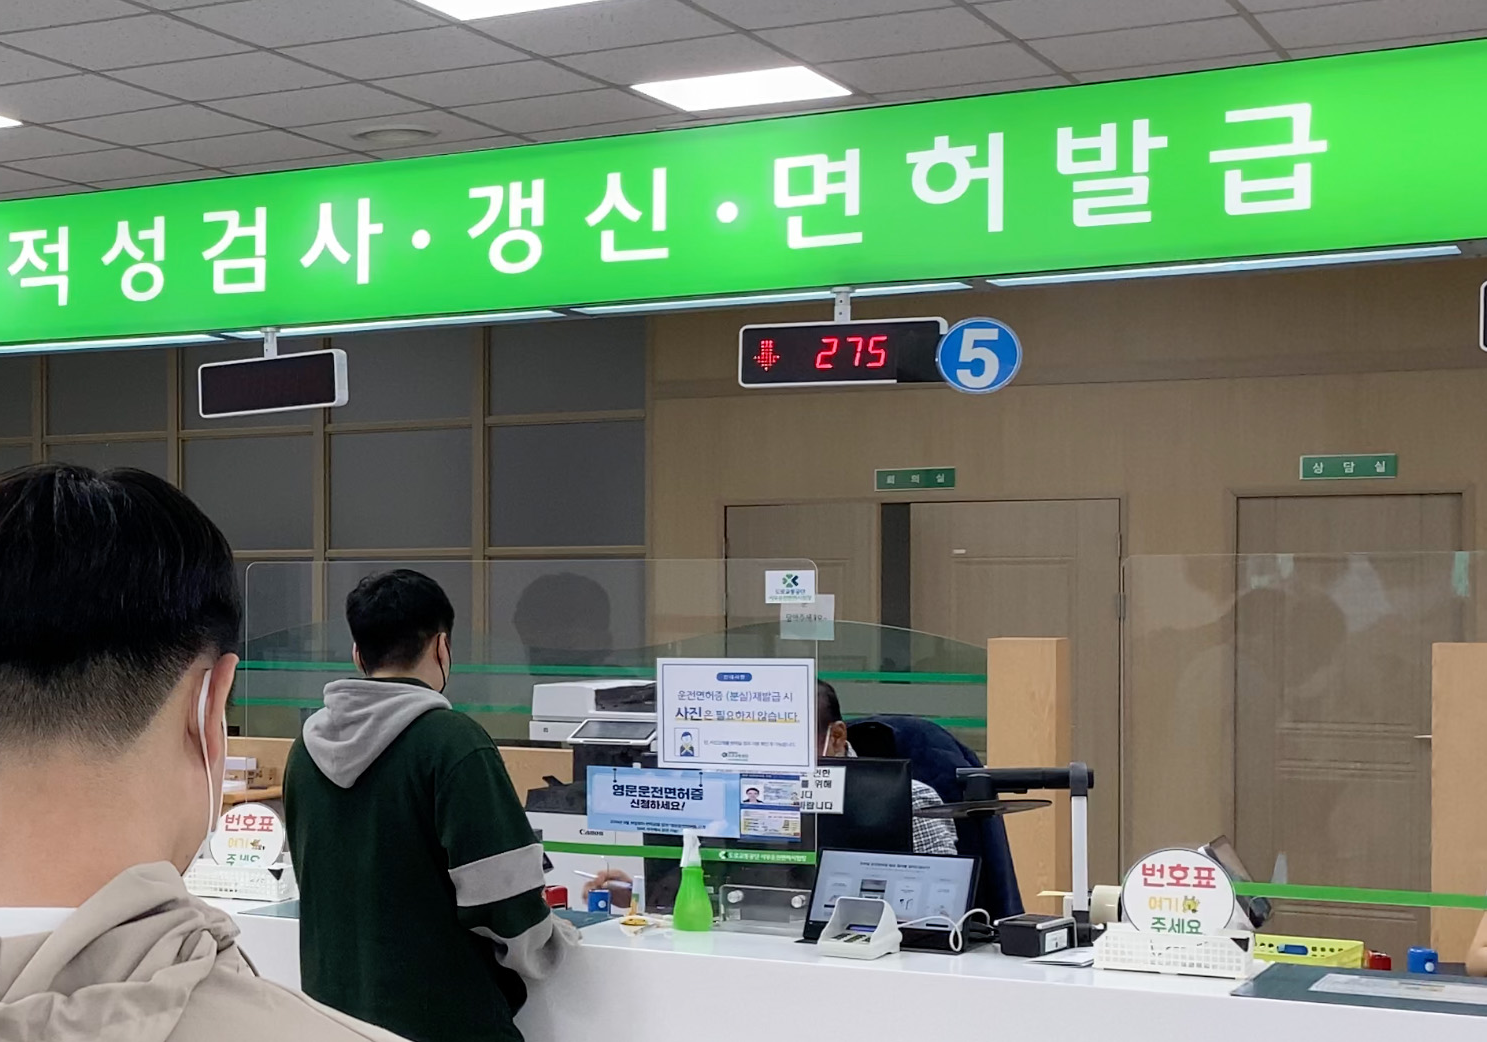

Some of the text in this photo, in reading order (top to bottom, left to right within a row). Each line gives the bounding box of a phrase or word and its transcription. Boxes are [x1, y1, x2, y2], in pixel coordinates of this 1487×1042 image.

[814, 328, 1000, 389] 275 5
[1312, 460, 1386, 475] 상담실
[677, 690, 723, 701] 운전면허증
[716, 710, 754, 721] 필요하지
[612, 784, 704, 801] 영문운전면허증
[630, 799, 686, 811] 신청하세요!
[225, 813, 274, 832] 번호표
[1142, 863, 1216, 889] 번호표
[1150, 917, 1204, 935] 주세요
